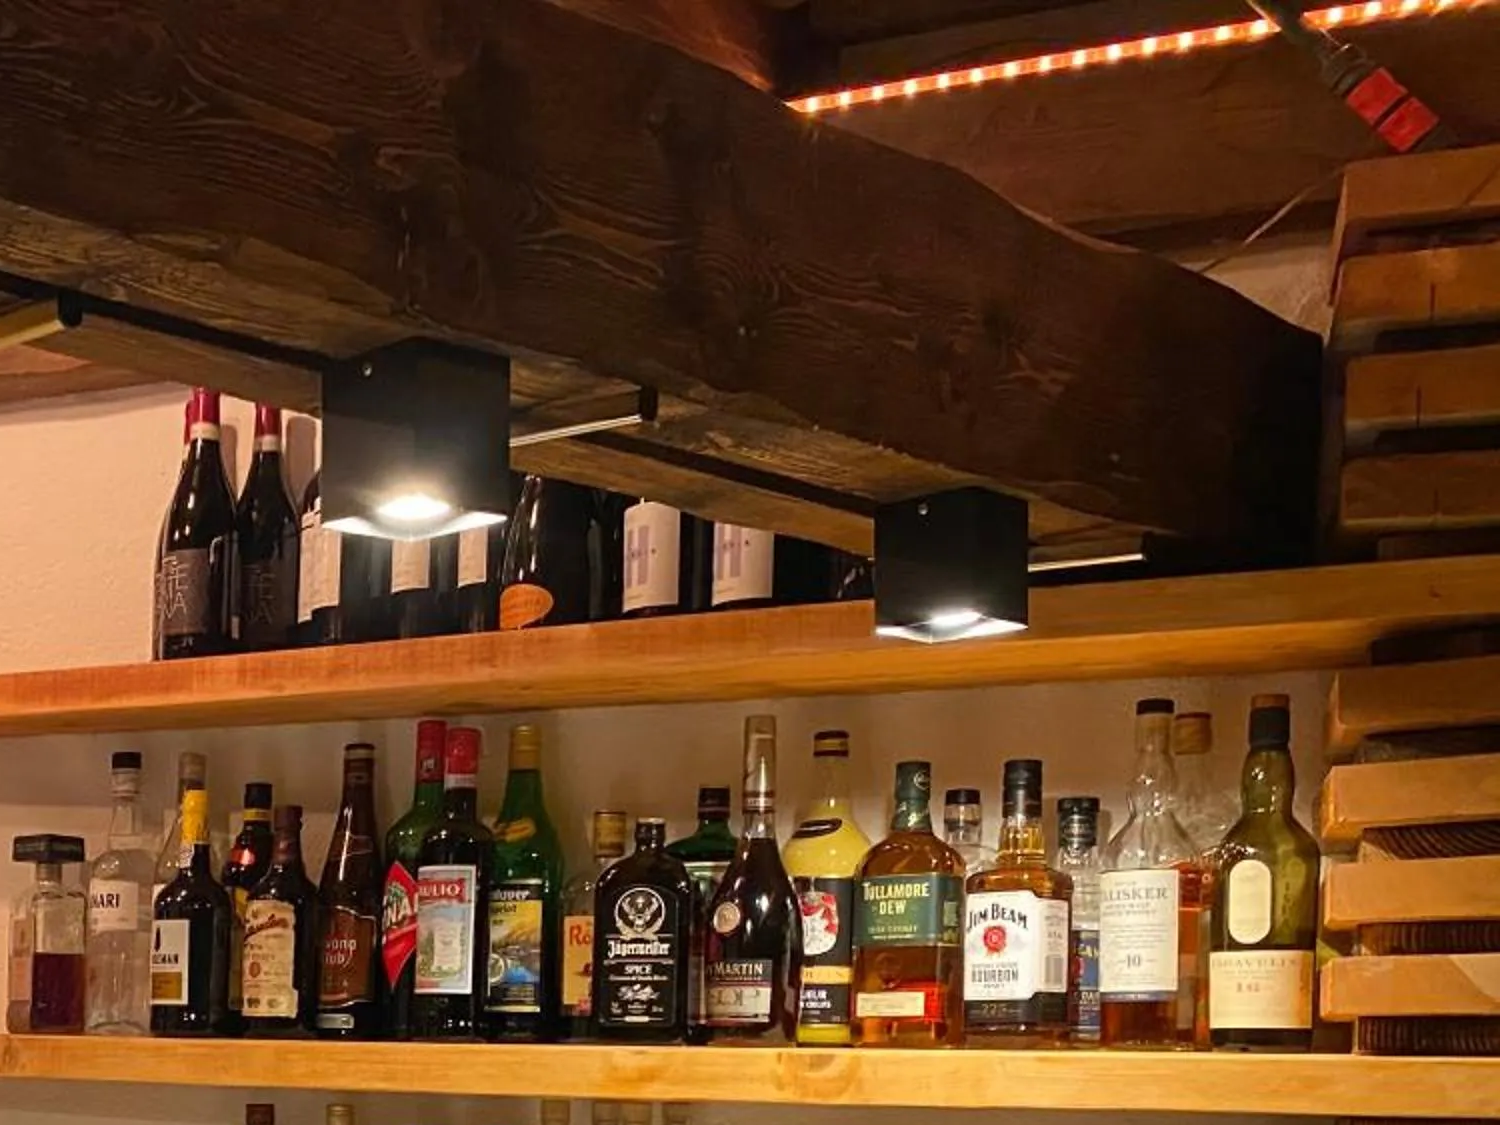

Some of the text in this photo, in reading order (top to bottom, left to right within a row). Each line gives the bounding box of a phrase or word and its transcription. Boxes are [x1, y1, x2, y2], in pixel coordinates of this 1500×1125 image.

[862, 882, 930, 900] TULLAMORE
[967, 903, 1028, 931] JIM BEAM
[714, 961, 763, 976] MARTIN
